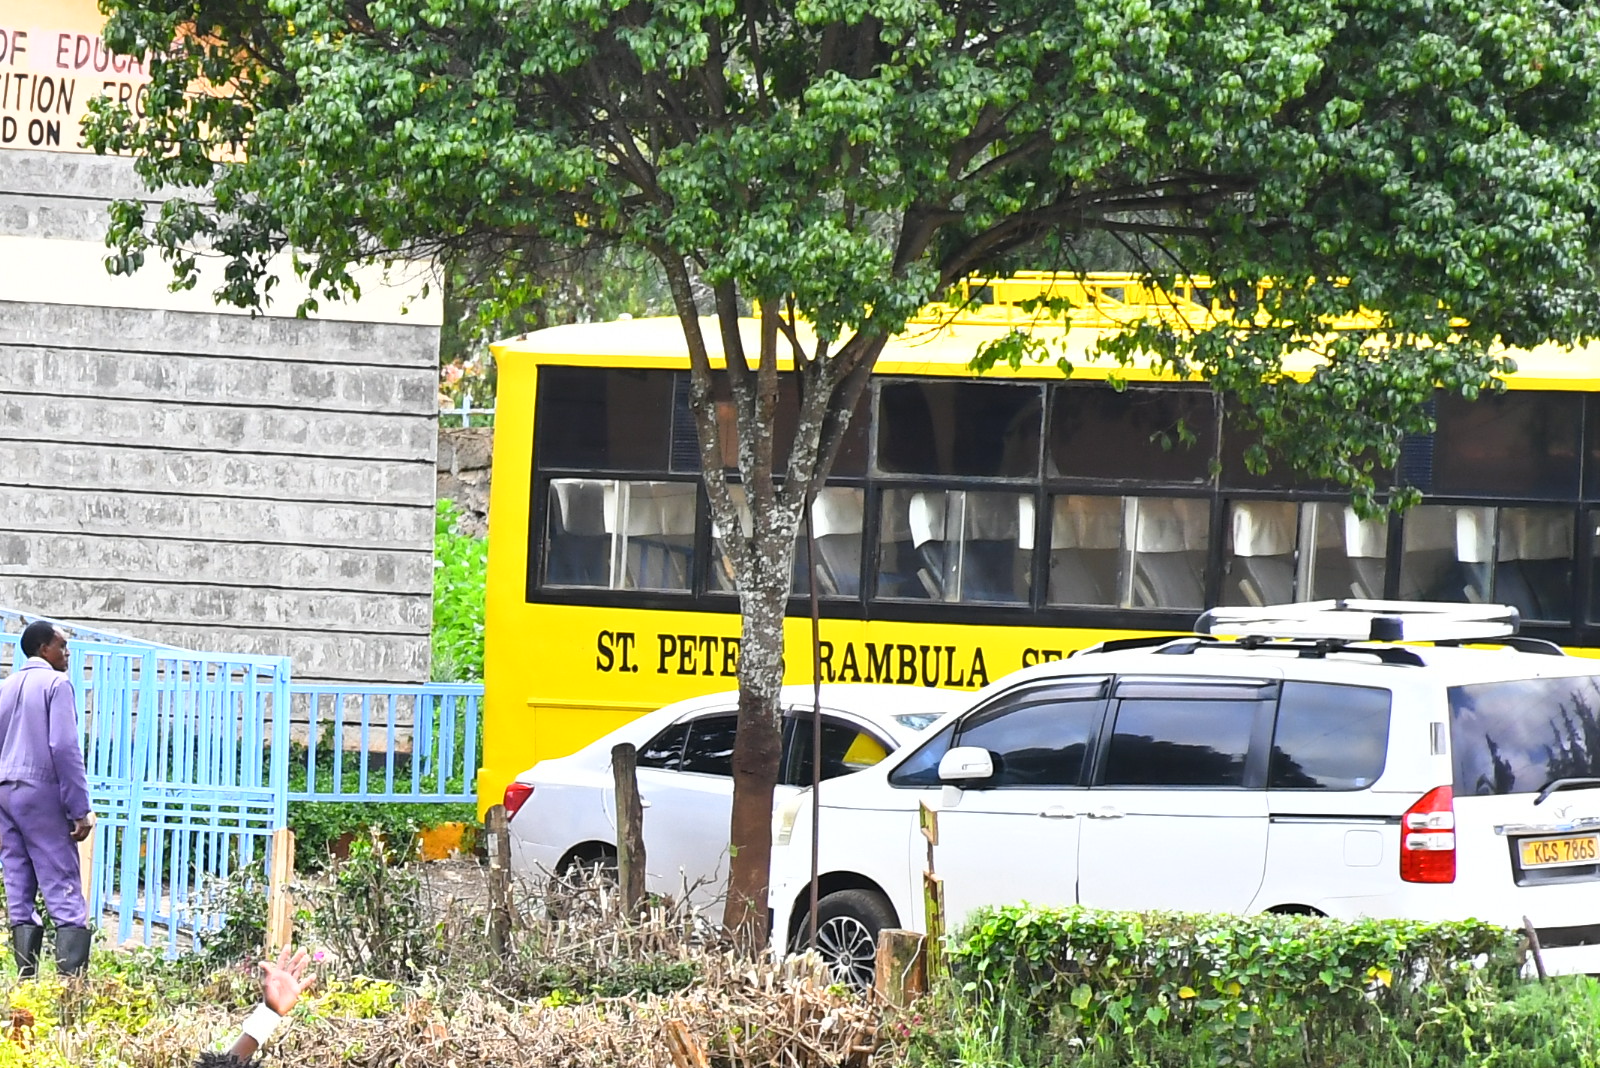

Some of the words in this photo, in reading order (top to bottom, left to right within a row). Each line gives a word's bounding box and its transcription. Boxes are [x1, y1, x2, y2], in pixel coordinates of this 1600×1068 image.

[56, 33, 152, 76] EDUCA
[103, 81, 150, 119] FRO
[27, 118, 62, 147] ON
[596, 629, 639, 674] ST.
[656, 633, 786, 679] PETE
[814, 640, 990, 688] RAMBULA
[1533, 841, 1559, 863] KCS
[1563, 839, 1596, 861] 786S
